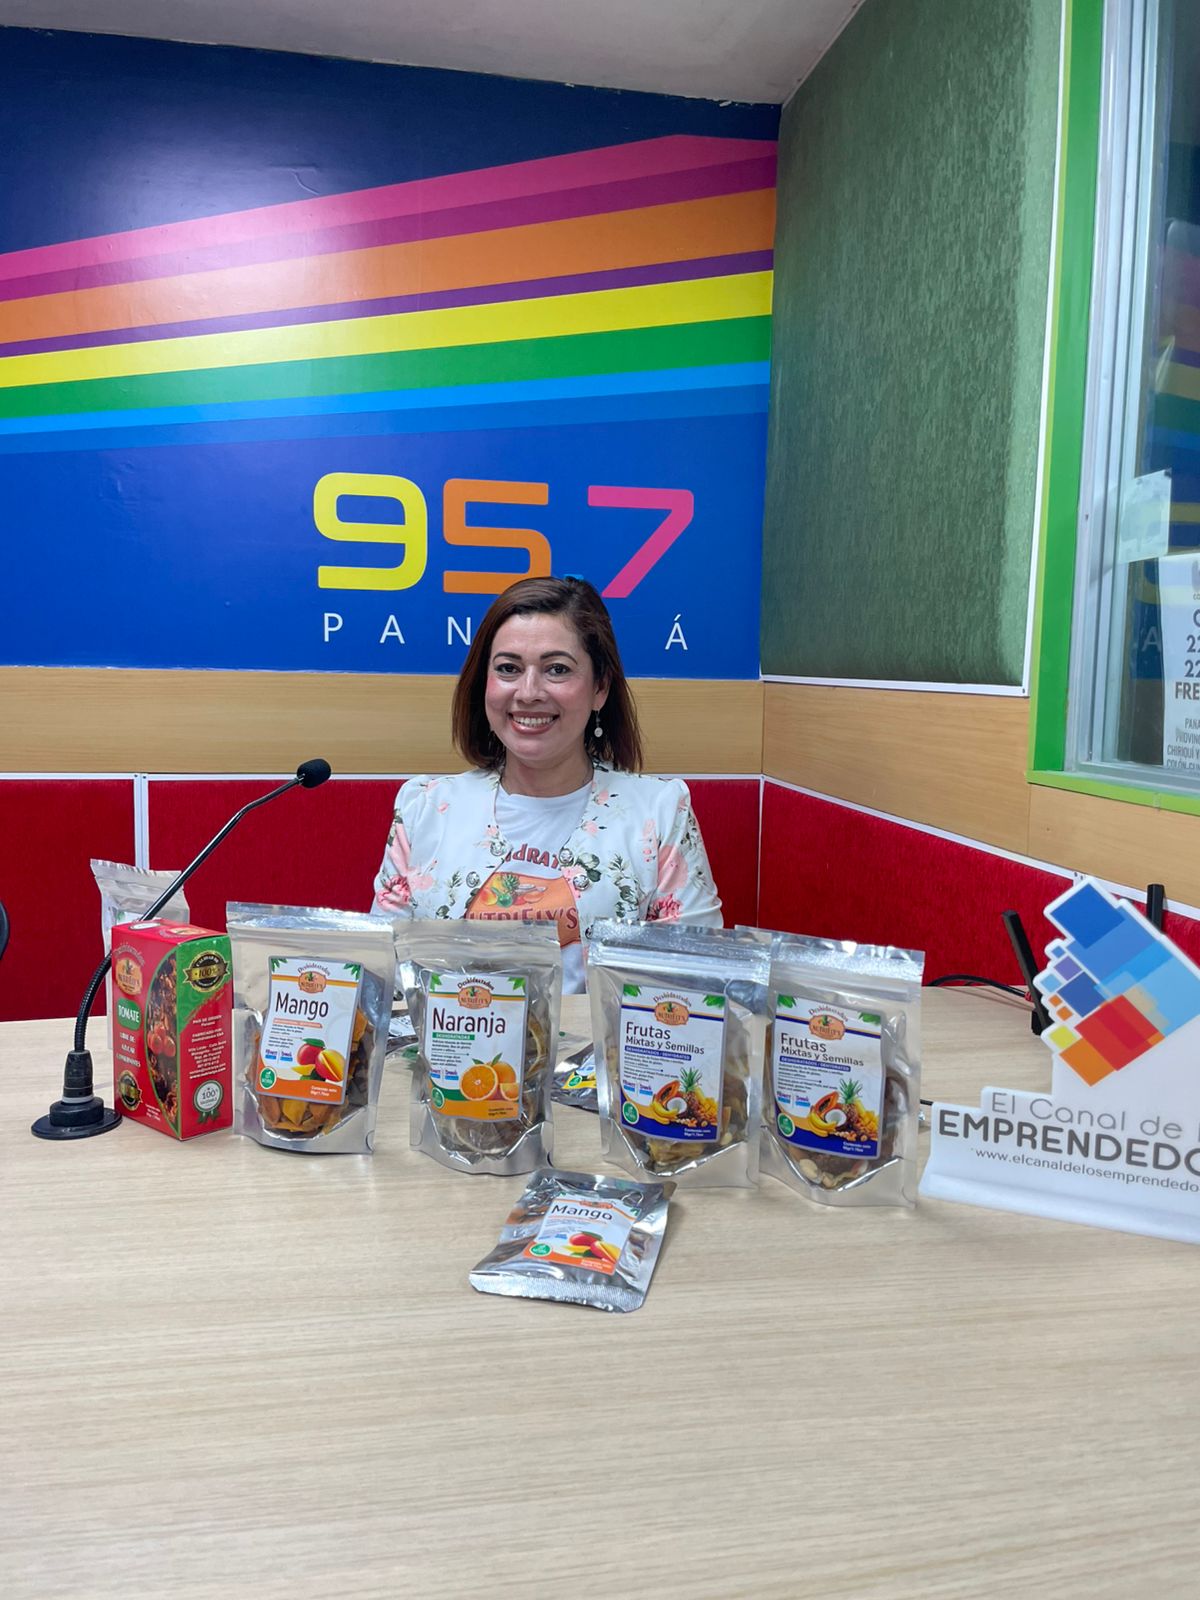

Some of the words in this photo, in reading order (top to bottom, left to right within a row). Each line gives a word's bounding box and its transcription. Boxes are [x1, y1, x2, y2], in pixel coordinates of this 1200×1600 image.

[118, 1005, 140, 1023] TOMATE
[275, 991, 329, 1021] Mango
[432, 1007, 506, 1038] Naranja
[626, 1021, 671, 1040] Frutas
[625, 1035, 655, 1048] Mixtas
[657, 1041, 663, 1050] y
[665, 1040, 705, 1055] Semillas
[780, 1032, 827, 1053] Frutas
[781, 1046, 812, 1058] Mixtas
[822, 1053, 864, 1066] Semillas
[991, 1091, 1016, 1114] El
[1029, 1097, 1126, 1131] Canal
[1140, 1116, 1183, 1140] de
[938, 1109, 1200, 1177] EMPRENDEDO
[551, 1204, 613, 1221] Mango
